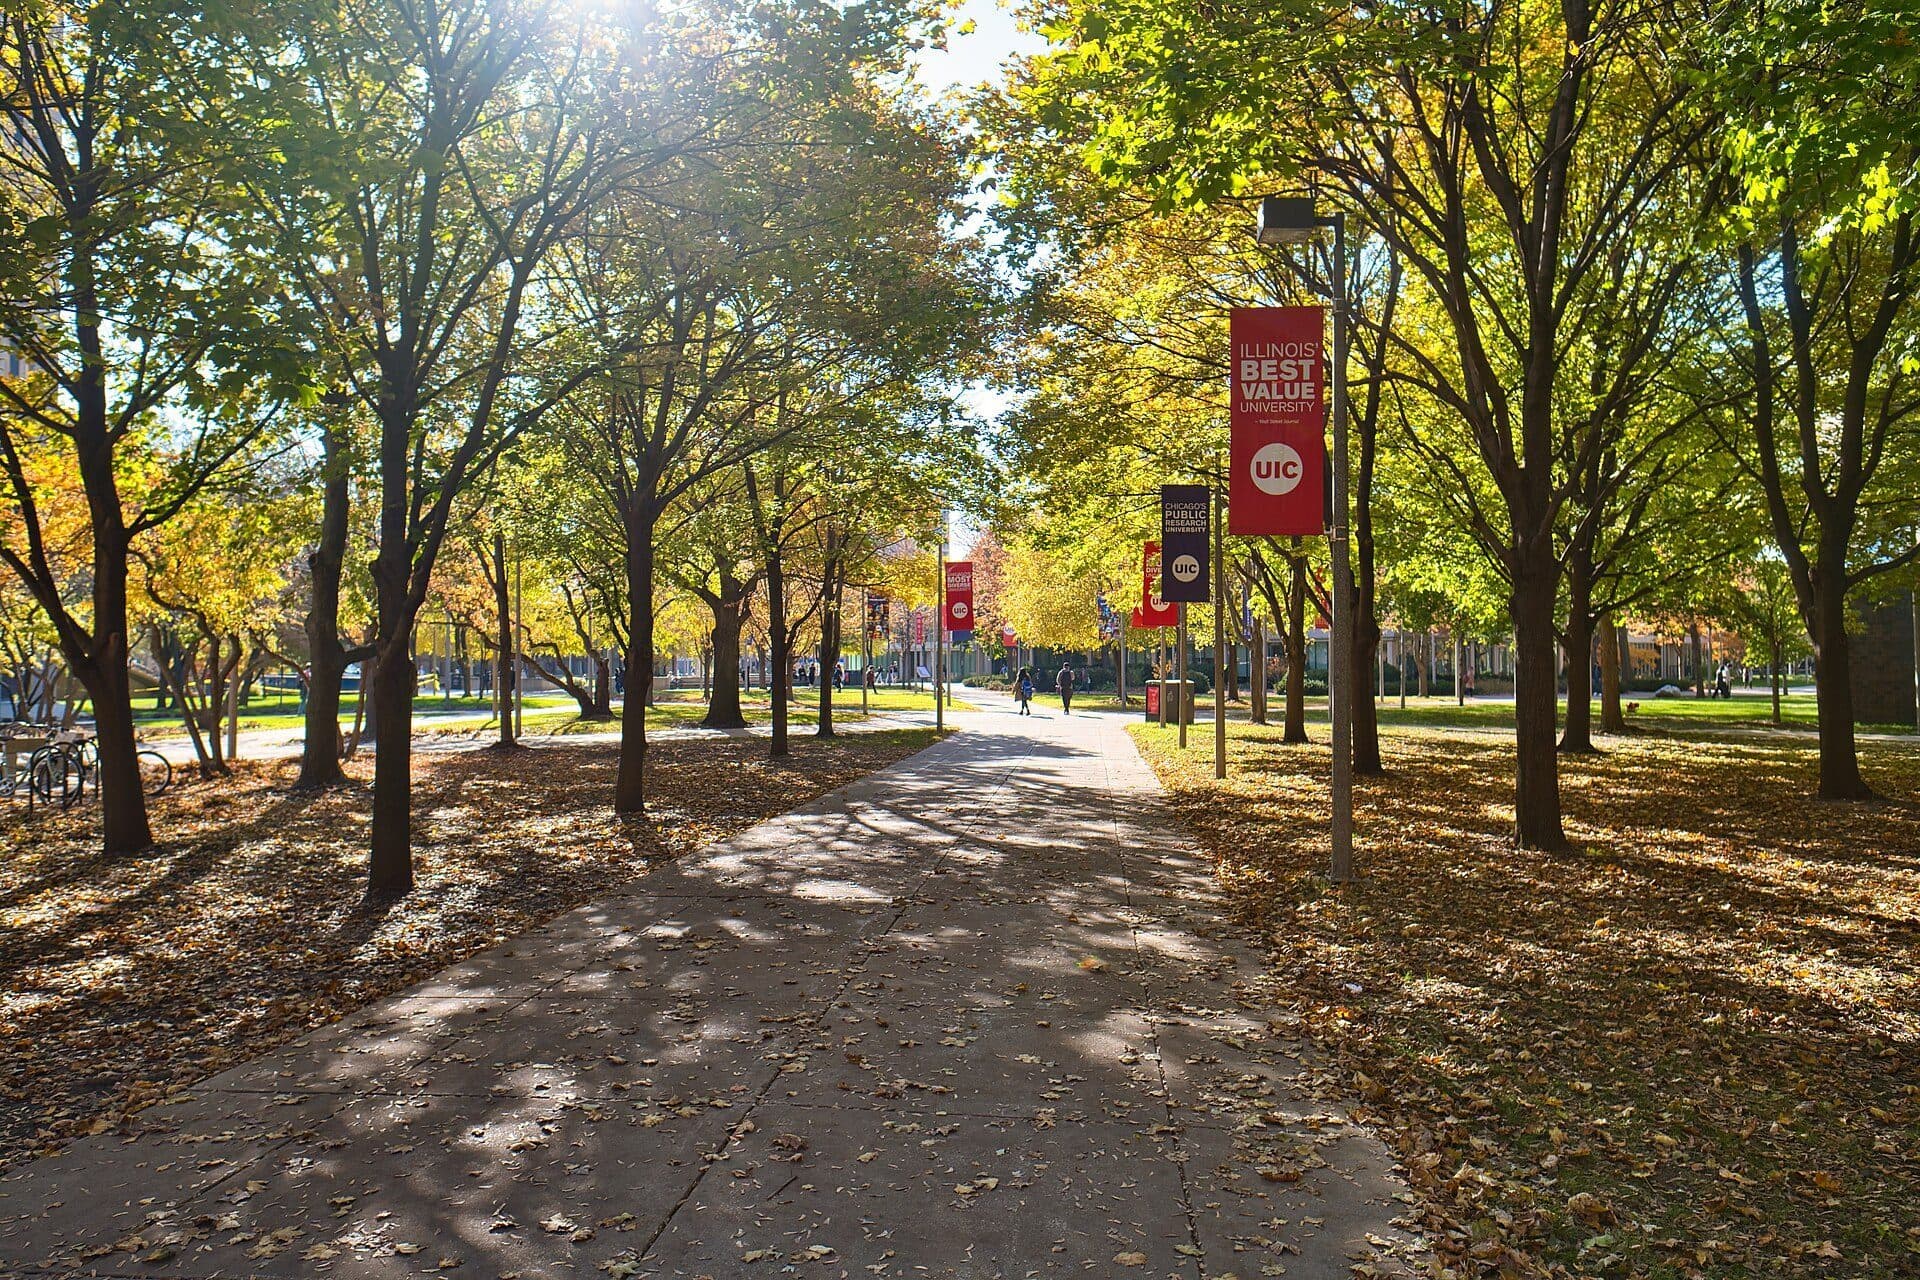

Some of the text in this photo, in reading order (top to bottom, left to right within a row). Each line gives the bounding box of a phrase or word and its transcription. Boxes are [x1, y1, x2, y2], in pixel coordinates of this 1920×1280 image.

[1240, 342, 1319, 358] ILLINOIS'
[1240, 359, 1315, 381] BEST
[1240, 382, 1315, 400] VALUE
[1240, 401, 1315, 413] UNIVERSITY
[1256, 461, 1298, 479] UIC
[1165, 502, 1207, 510] CHICAGO'S
[1165, 510, 1207, 519] PUBLIC
[1165, 519, 1207, 527] RESEARCH
[1175, 564, 1197, 574] UIC
